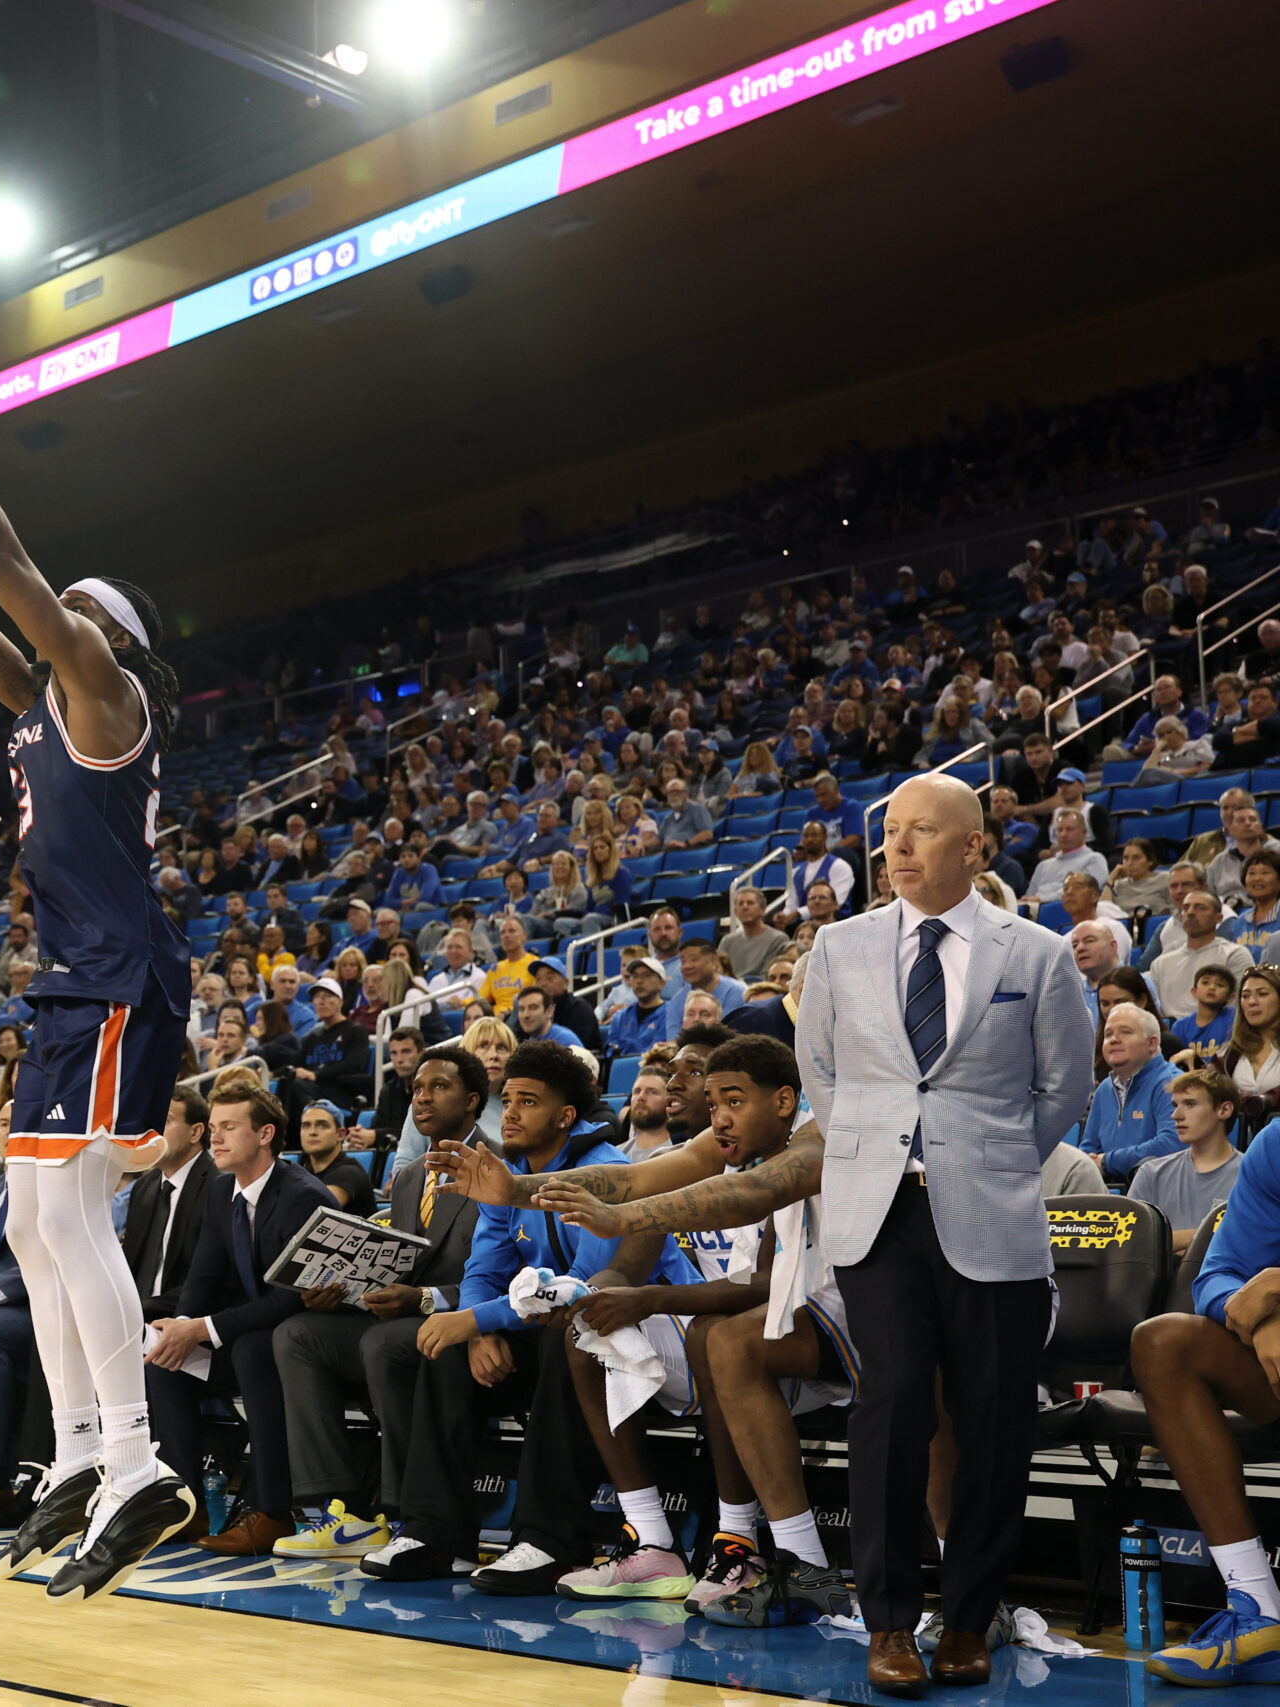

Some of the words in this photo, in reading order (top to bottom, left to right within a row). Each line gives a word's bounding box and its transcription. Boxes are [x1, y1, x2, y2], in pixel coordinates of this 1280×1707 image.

[635, 102, 700, 145] Take
[707, 95, 724, 117] a
[730, 38, 856, 108] time-out
[861, 8, 937, 56] from
[370, 197, 465, 257] @flyONT
[46, 362, 67, 382] Fly
[74, 341, 114, 369] ONT.
[346, 1235, 363, 1248] 24
[360, 1247, 375, 1260] 23
[381, 1249, 394, 1258] 13
[400, 1255, 413, 1264] 14
[331, 1259, 348, 1272] 25
[473, 1475, 505, 1493] alth
